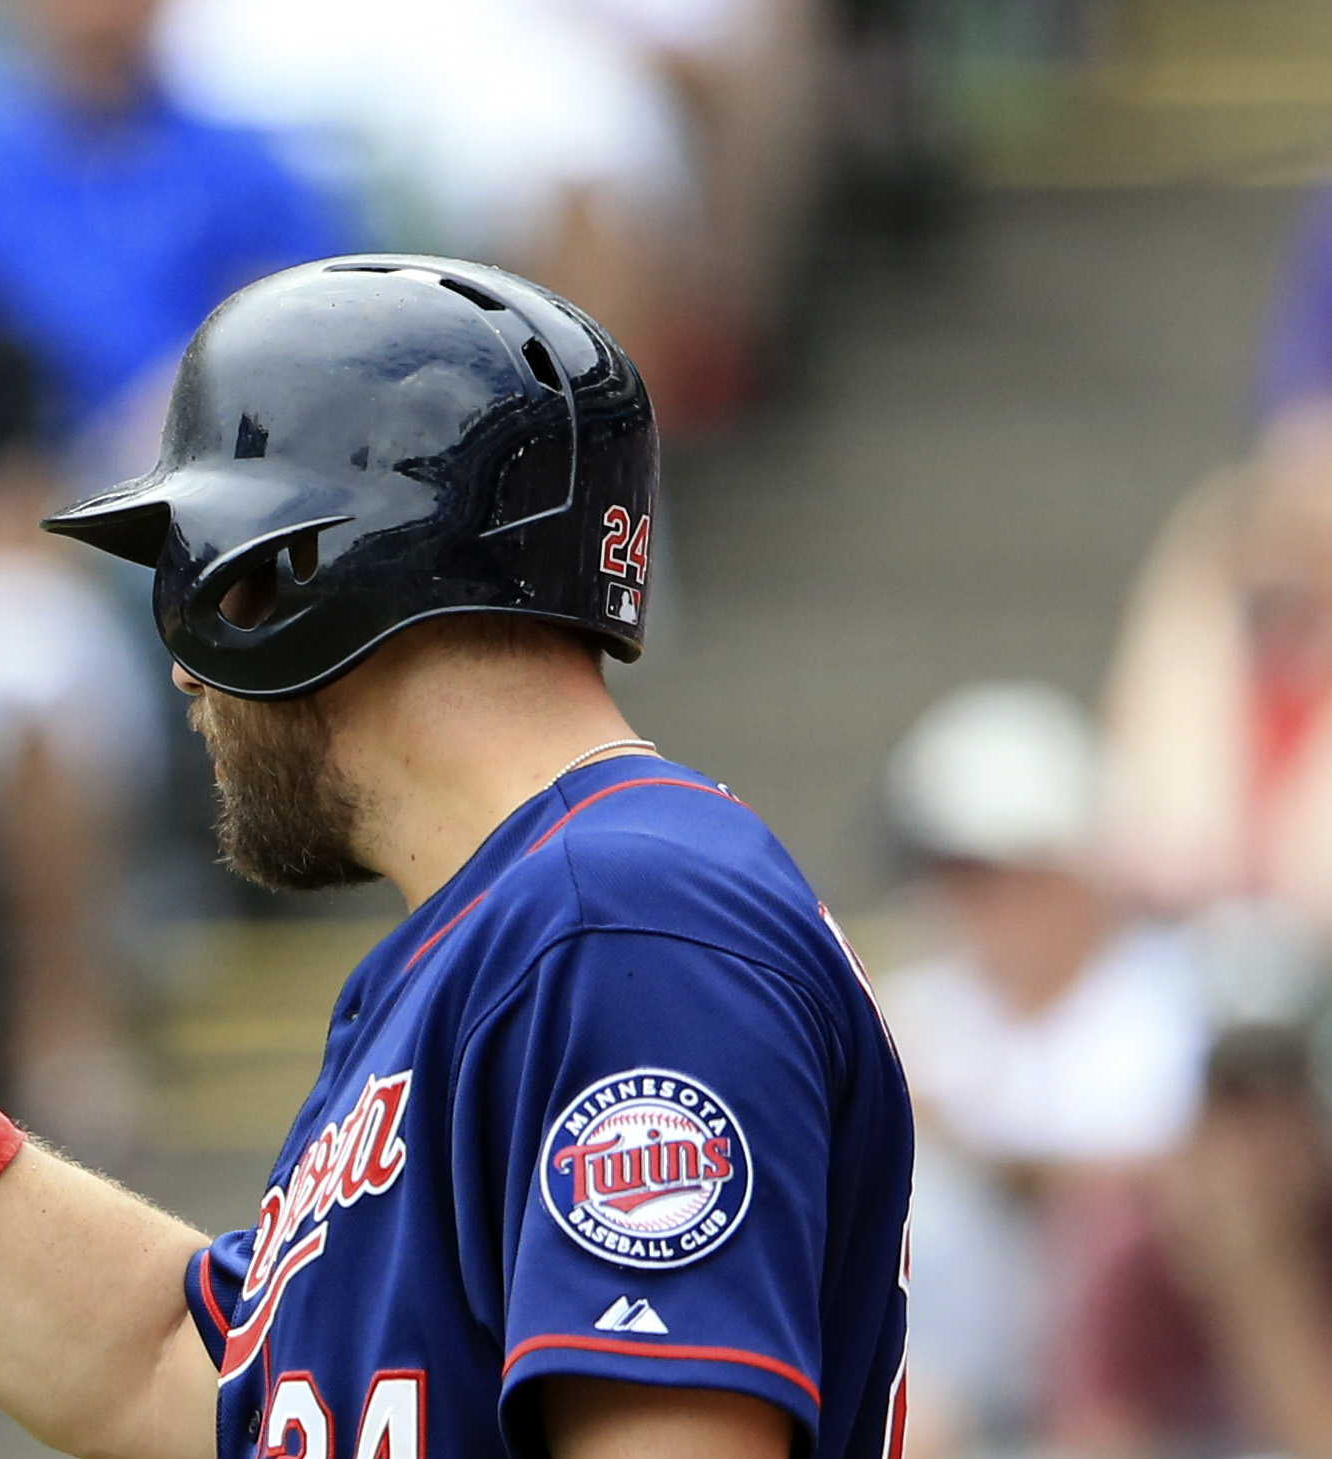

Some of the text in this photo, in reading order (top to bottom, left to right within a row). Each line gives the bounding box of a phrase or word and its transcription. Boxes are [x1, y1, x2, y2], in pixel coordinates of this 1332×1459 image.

[600, 504, 651, 585] 24
[564, 1078, 728, 1137] MINNESOTA
[553, 1128, 734, 1208] Twins
[568, 1208, 728, 1258] BASEBALL CLUB
